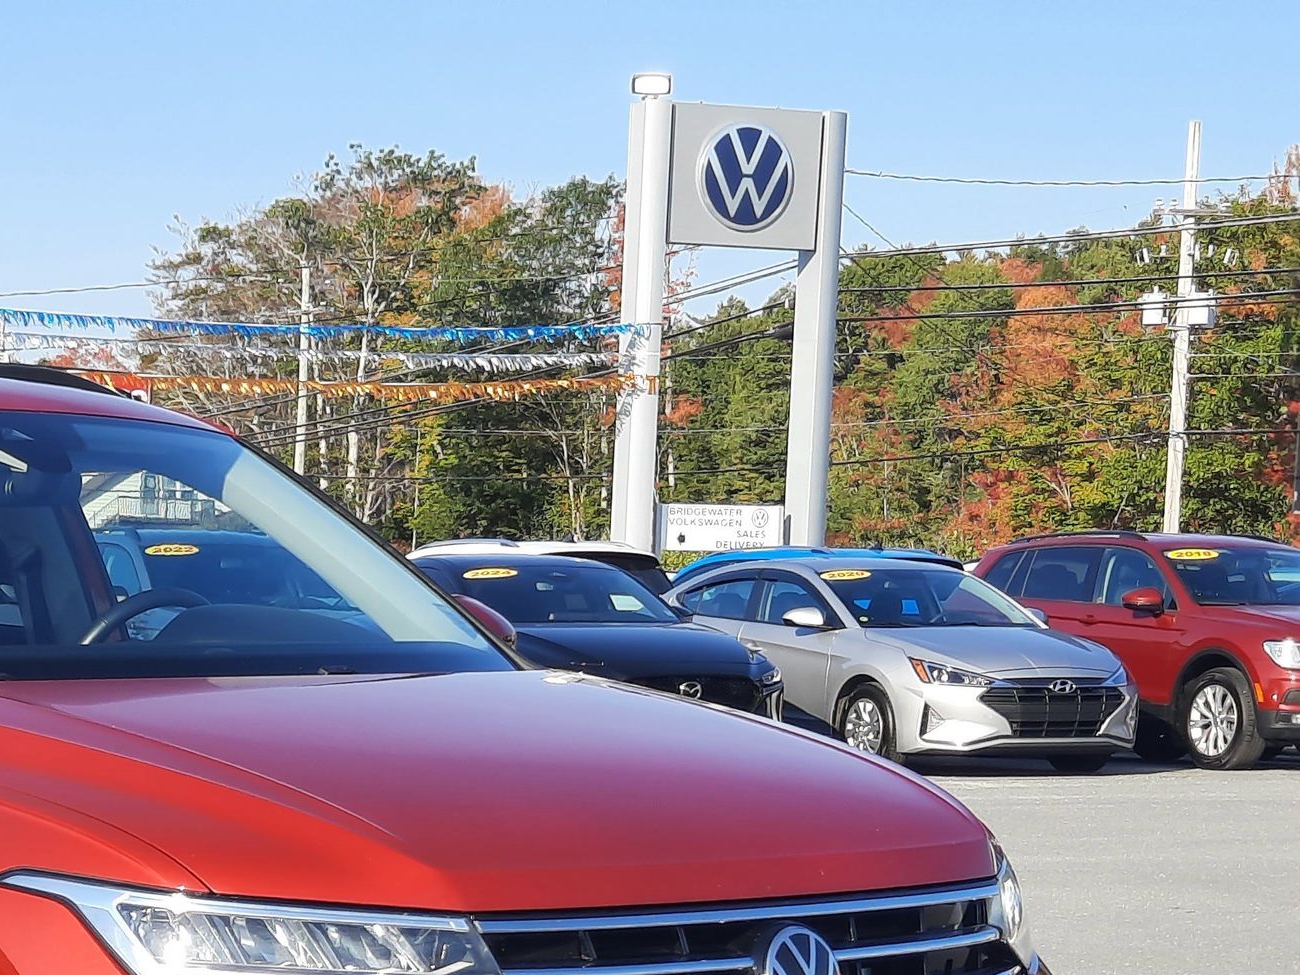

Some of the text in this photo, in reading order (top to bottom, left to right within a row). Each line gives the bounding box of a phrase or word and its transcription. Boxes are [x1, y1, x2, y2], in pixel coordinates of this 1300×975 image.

[669, 507, 742, 516] BRIDGEWATER
[669, 518, 742, 527] VOLKSWAGEN
[736, 530, 766, 538] SALES
[715, 540, 765, 549] DELIVERY
